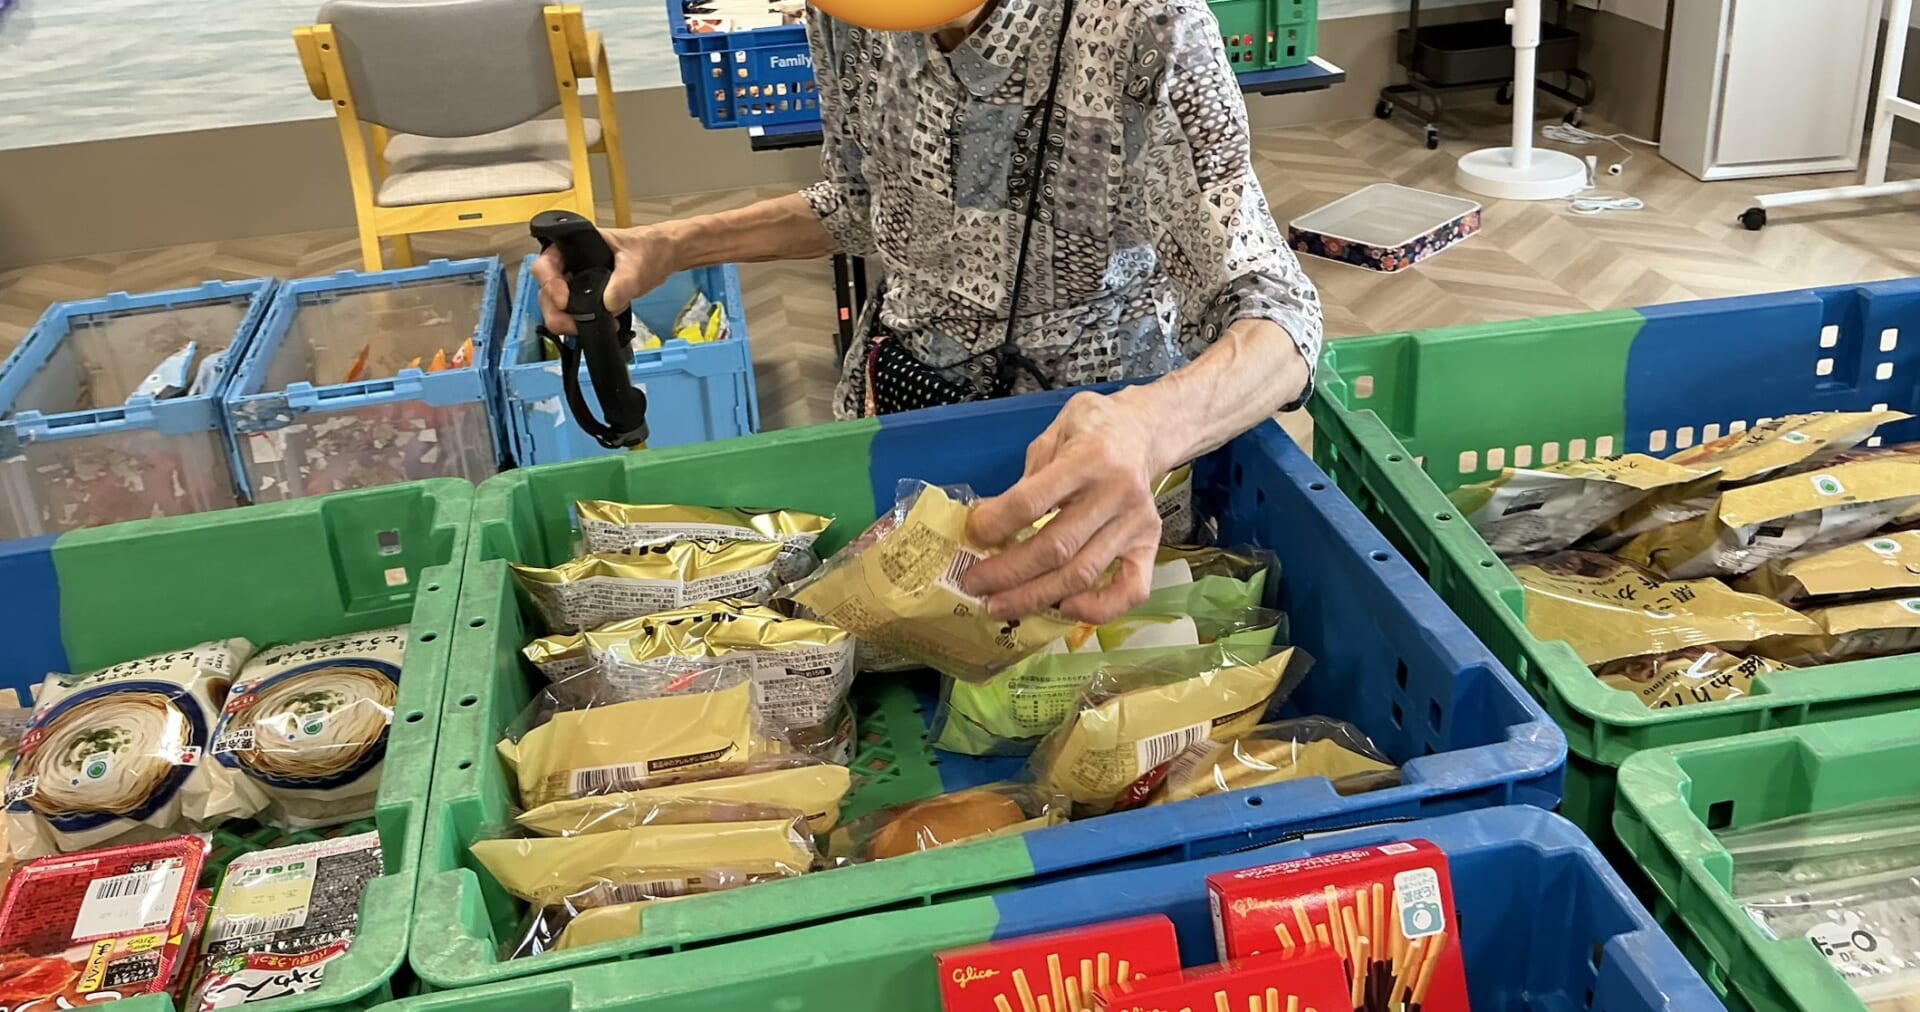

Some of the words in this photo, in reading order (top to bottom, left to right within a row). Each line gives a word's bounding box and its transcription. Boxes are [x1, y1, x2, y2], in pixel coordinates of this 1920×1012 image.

[770, 54, 812, 68] Family
[1642, 671, 1676, 697] Karinto
[952, 967, 999, 988] Glico
